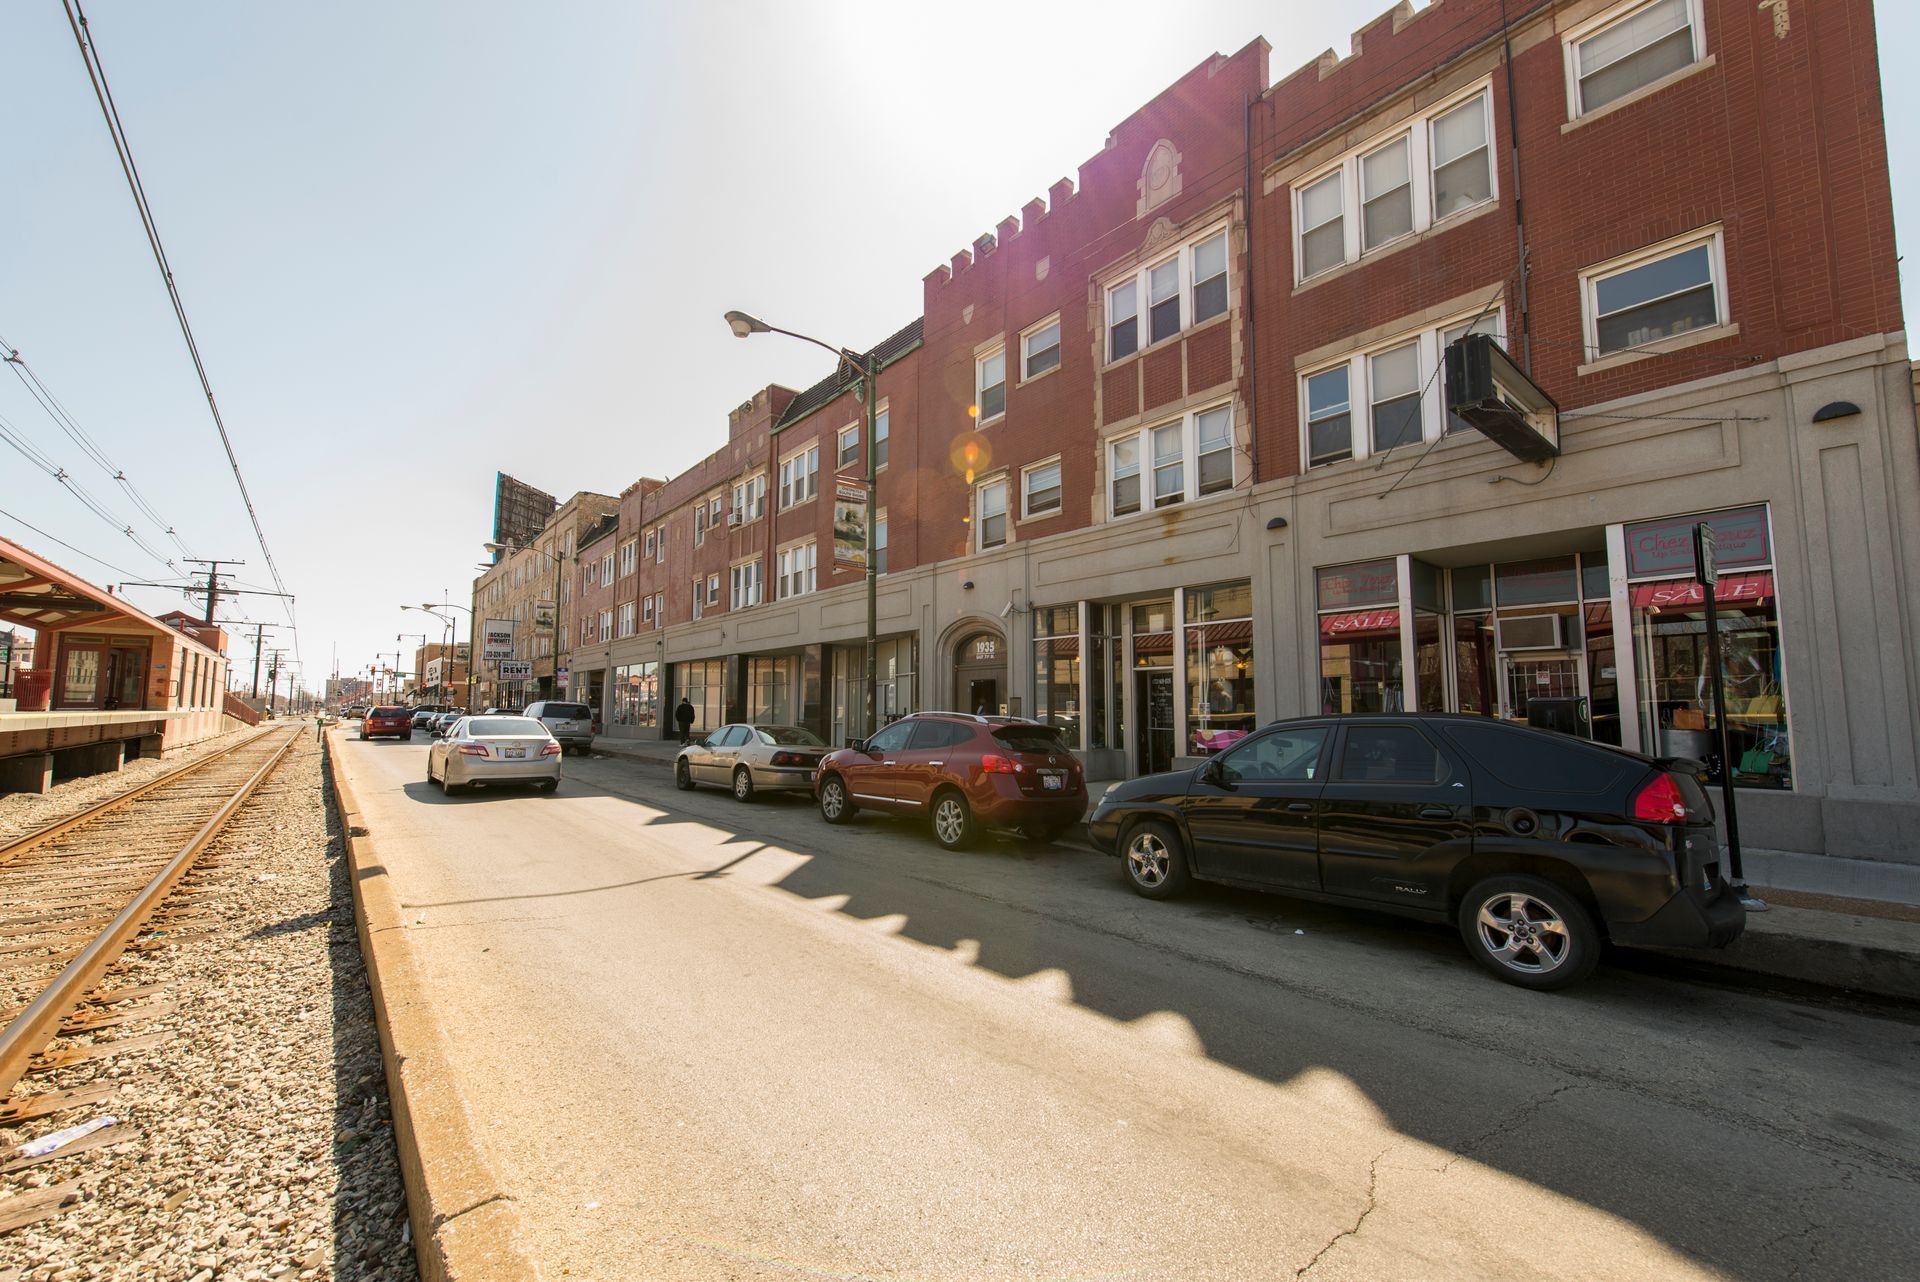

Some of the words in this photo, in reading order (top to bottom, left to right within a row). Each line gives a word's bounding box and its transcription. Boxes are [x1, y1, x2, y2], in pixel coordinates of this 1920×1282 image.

[1640, 532, 1690, 552] Chez
[1331, 616, 1393, 630] SALE
[976, 641, 995, 653] 1935
[1395, 886, 1428, 894] RALLY
